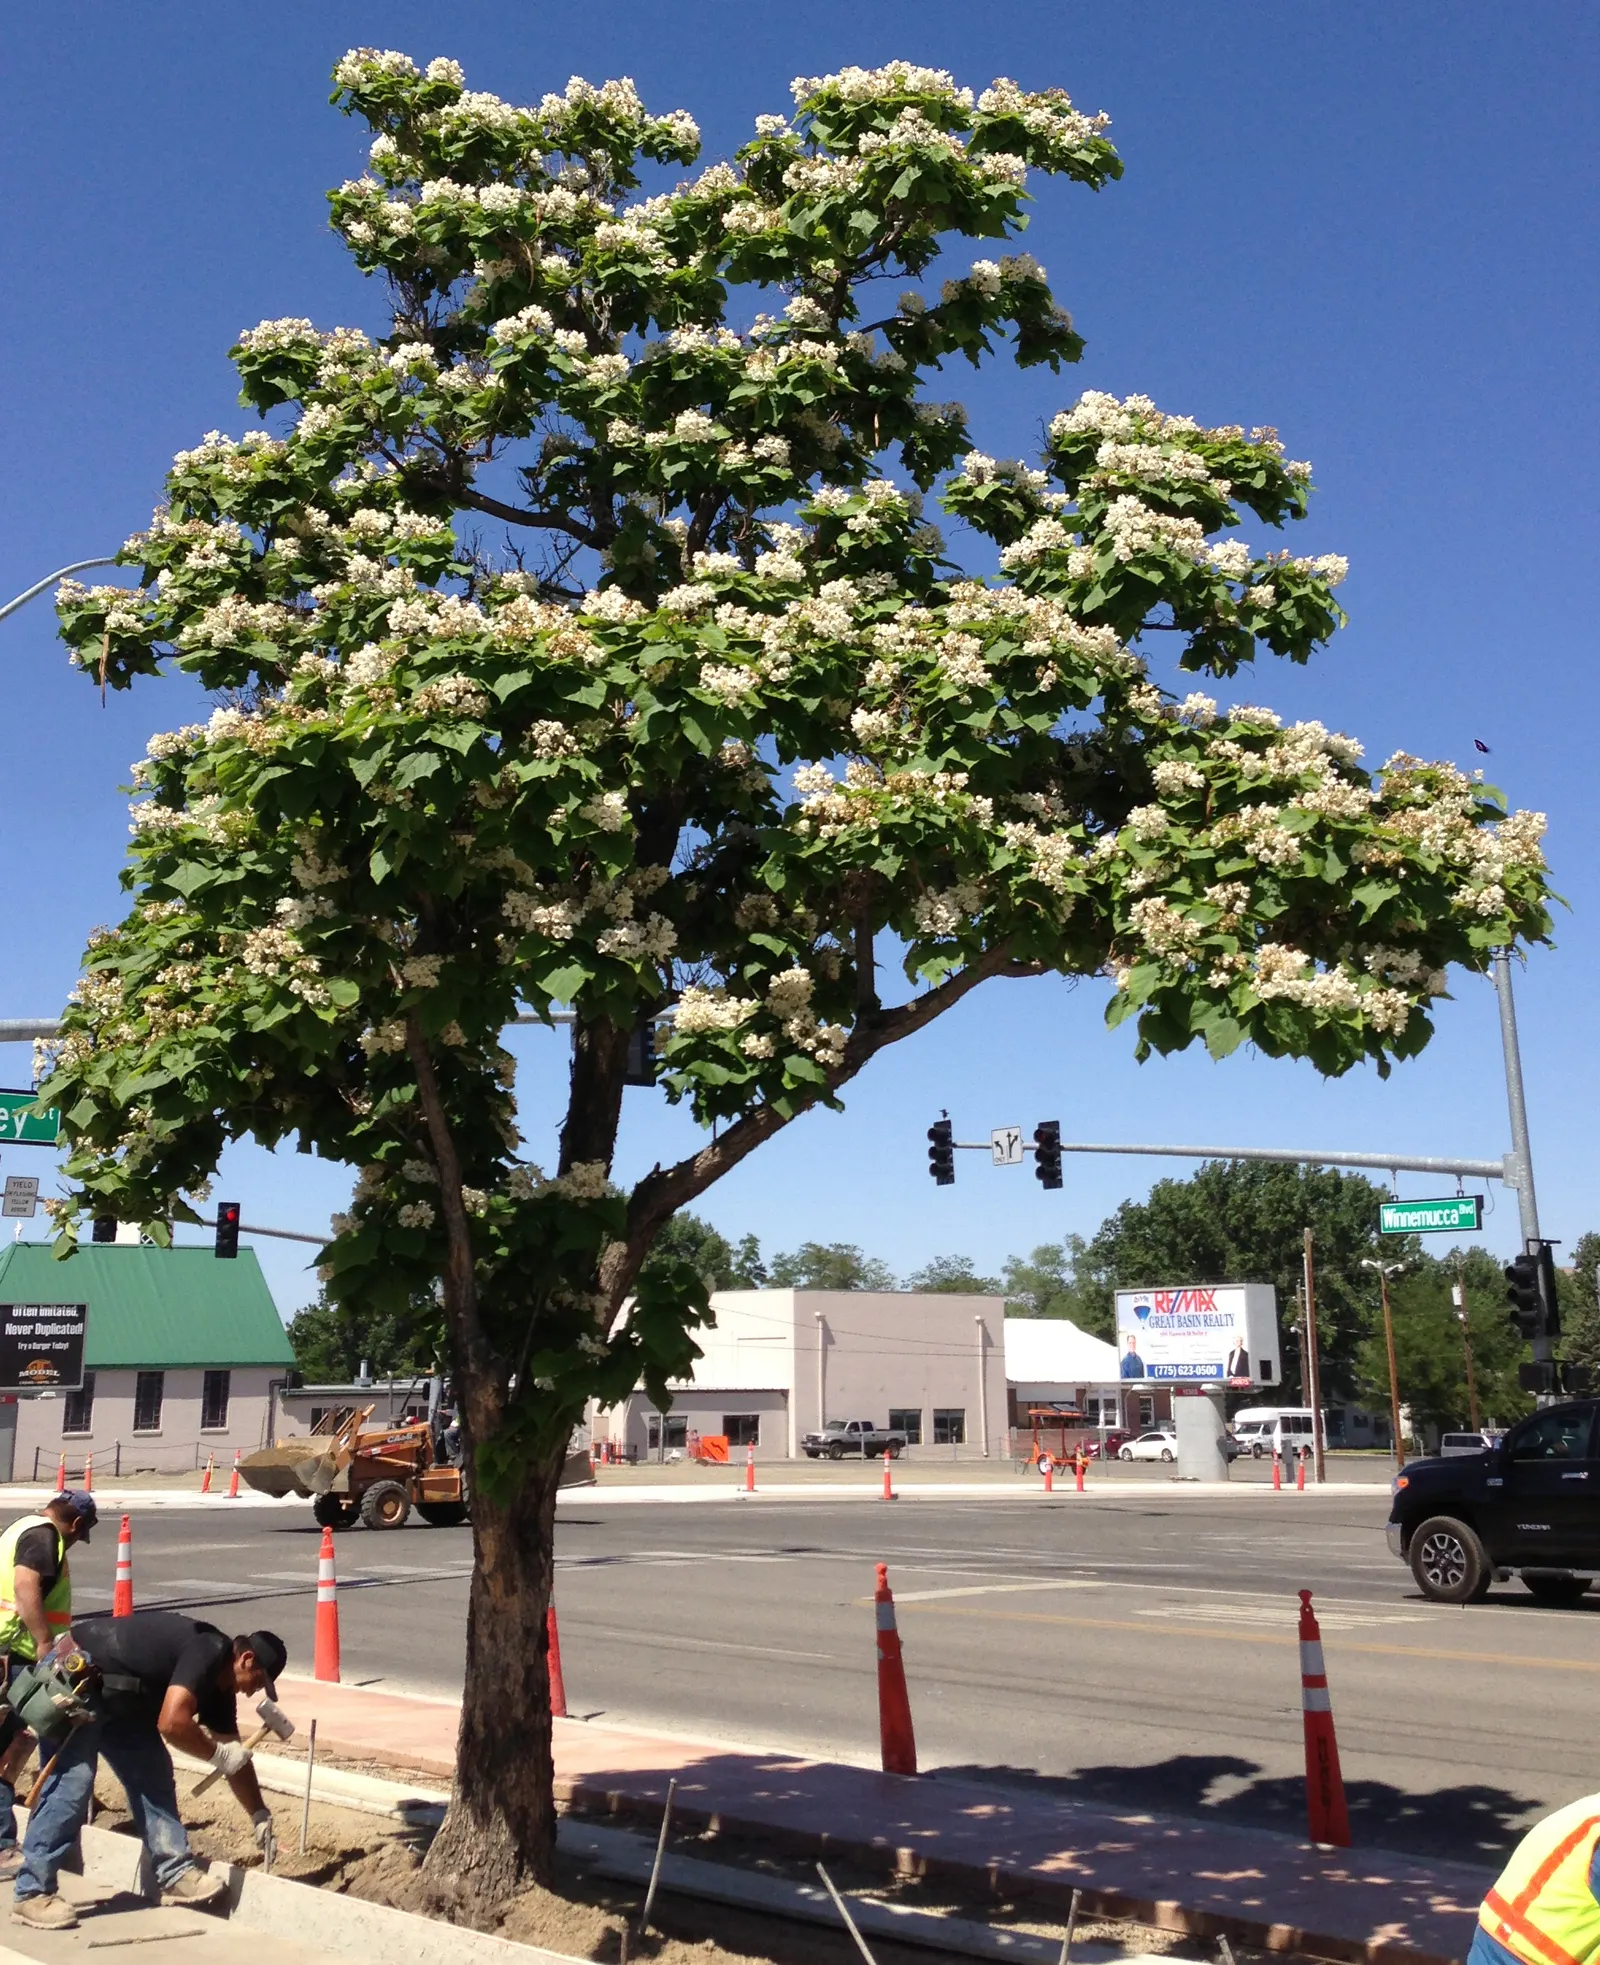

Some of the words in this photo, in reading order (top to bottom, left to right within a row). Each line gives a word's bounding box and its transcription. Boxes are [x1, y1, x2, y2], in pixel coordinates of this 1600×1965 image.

[12, 1181, 33, 1189] YIELD
[1383, 1208, 1459, 1228] Winnemucca
[1458, 1203, 1474, 1215] Blvd
[1155, 1289, 1218, 1314] RE/MAX
[1149, 1315, 1176, 1329] GREAT
[1177, 1314, 1201, 1328] BASIN
[1203, 1313, 1235, 1327] REALTY
[5, 1322, 34, 1336] Never
[34, 1322, 84, 1337] Duplicated!
[17, 1342, 28, 1350] Try
[32, 1342, 52, 1351] Burger
[52, 1342, 70, 1351] Today!
[18, 1369, 60, 1378] MODEL
[1155, 1365, 1176, 1377] (775)
[1178, 1365, 1217, 1376] 623-0500
